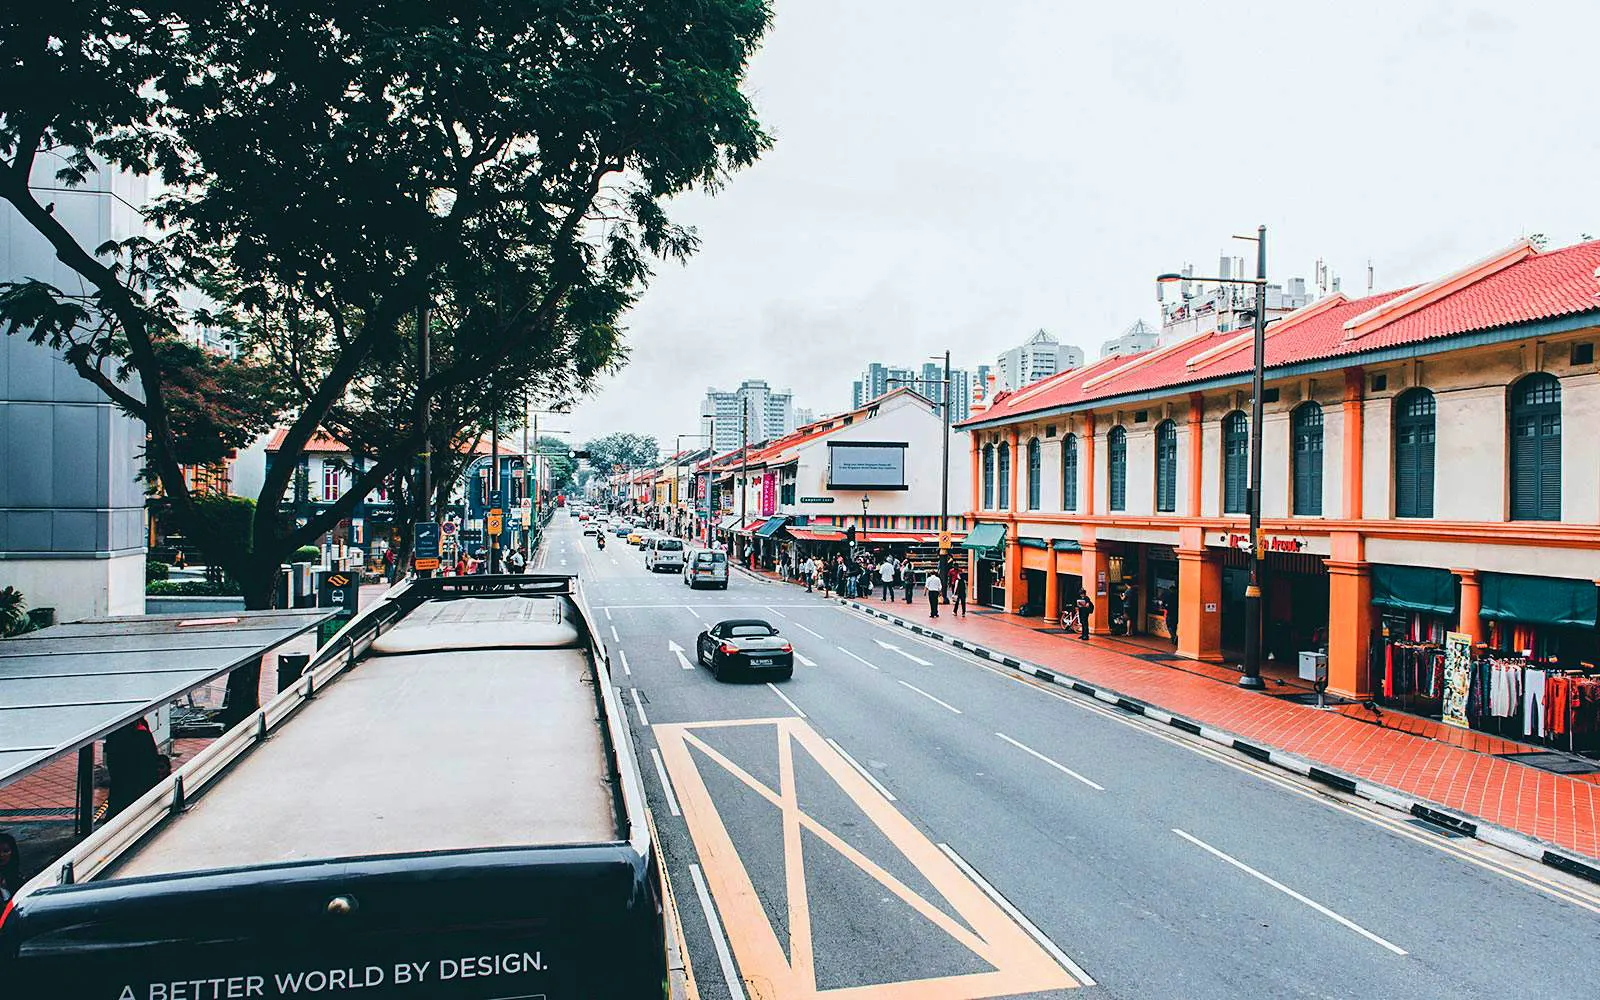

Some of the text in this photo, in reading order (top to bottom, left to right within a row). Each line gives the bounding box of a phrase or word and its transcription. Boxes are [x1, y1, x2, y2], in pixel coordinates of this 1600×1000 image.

[118, 951, 549, 1000] A BETTER WORLD BY DESIGN.
